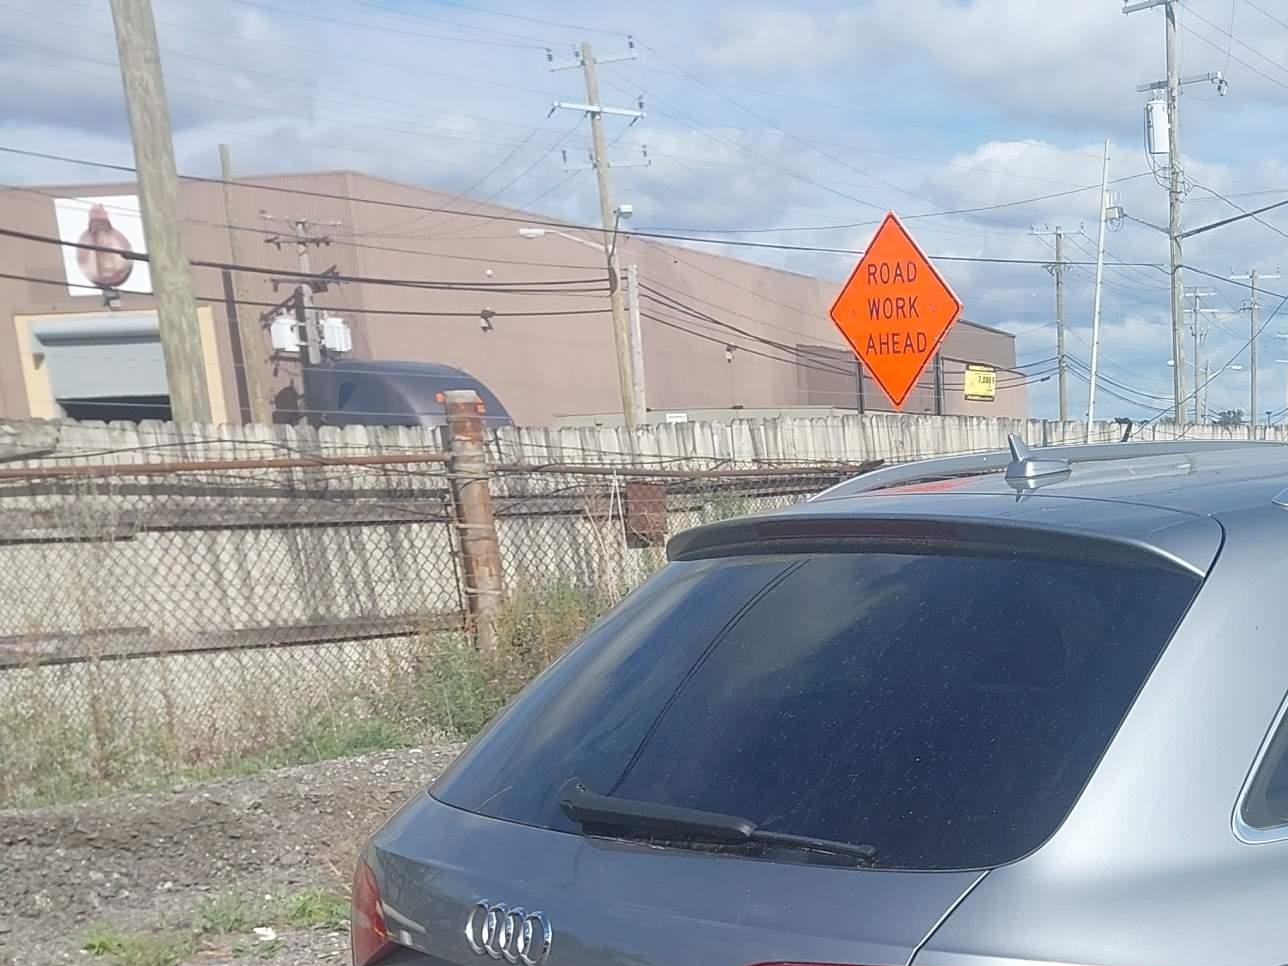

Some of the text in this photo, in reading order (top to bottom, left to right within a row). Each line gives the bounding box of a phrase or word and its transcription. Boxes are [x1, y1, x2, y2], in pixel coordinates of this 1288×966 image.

[867, 261, 917, 285] ROAD
[868, 296, 919, 320] WORK
[866, 332, 927, 355] AHEAD
